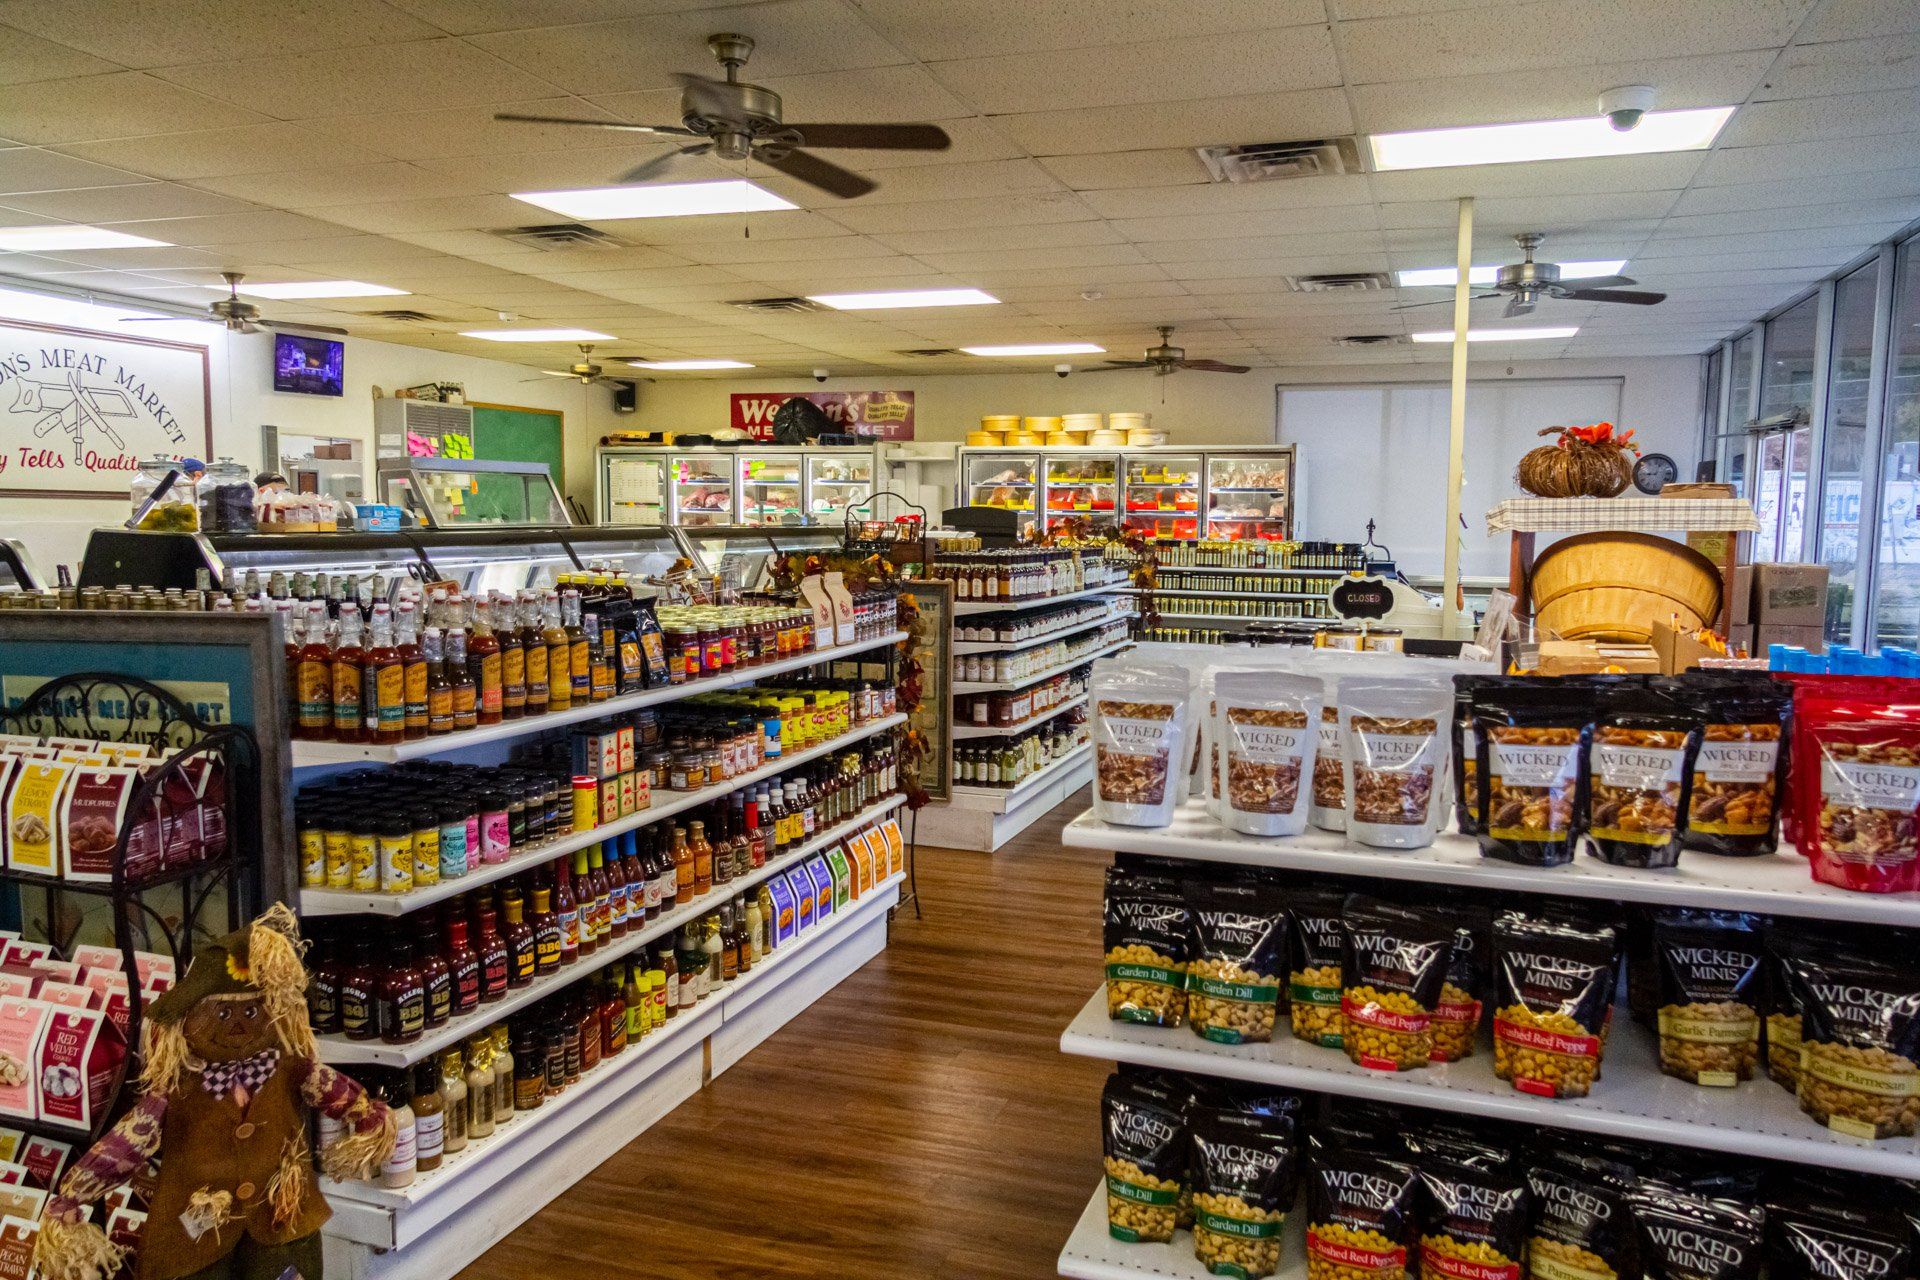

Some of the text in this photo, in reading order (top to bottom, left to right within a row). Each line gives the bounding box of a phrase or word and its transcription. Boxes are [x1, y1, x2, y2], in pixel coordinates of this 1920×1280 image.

[41, 348, 107, 375] MEAT
[114, 365, 186, 445] MARKET
[739, 399, 859, 423] Wen's
[747, 425, 900, 437] ME RKET
[19, 447, 65, 468] Tells
[1347, 594, 1381, 603] CLOSED
[1236, 731, 1296, 748] WICKED
[1500, 753, 1569, 767] WICKED
[1601, 753, 1672, 771] WICKED
[1703, 749, 1771, 764] WICKED
[1835, 769, 1917, 790] WICKED
[1117, 903, 1190, 924] WICKED
[1199, 912, 1273, 934] WICKED
[1130, 916, 1169, 932] MINIS
[1213, 928, 1254, 945] MINIS
[1508, 951, 1596, 980] WICKED
[1670, 948, 1758, 969] WICKED
[1117, 966, 1168, 981] Garden Dill
[1525, 970, 1573, 990] MINIS
[1691, 965, 1739, 981] MINIS
[1202, 982, 1253, 999] Garden Dill
[1378, 1013, 1397, 1027] Red
[1836, 1004, 1882, 1026] MINI
[57, 1032, 78, 1046] RED
[1673, 1022, 1751, 1037] Garlic Parmesan
[49, 1042, 80, 1057] VELVET
[1533, 1033, 1554, 1048] Red
[1556, 1039, 1588, 1053] Pepper
[1812, 1059, 1906, 1091] Garlic Parmesan
[1112, 1110, 1172, 1142] WICKED
[1123, 1128, 1157, 1149] MINIS
[1206, 1143, 1278, 1171] WICKED
[1218, 1161, 1260, 1181] MINIS
[1109, 1179, 1152, 1202] Garden Dill
[1210, 1184, 1231, 1194] OYSTER
[1321, 1170, 1401, 1201] WICKED
[1338, 1189, 1383, 1210] MINIS
[1528, 1177, 1612, 1221] WICKED
[1447, 1202, 1493, 1222] MINIS
[1544, 1201, 1589, 1228] MINIS
[1207, 1216, 1260, 1236] Garden Dill
[1314, 1240, 1398, 1267] Crushed Red Pepper
[1647, 1225, 1743, 1267] WICKED
[1786, 1236, 1889, 1275] WICKED
[1, 1251, 28, 1265] PECAN
[1668, 1247, 1720, 1275] MINIS
[1460, 1264, 1478, 1278] Red
